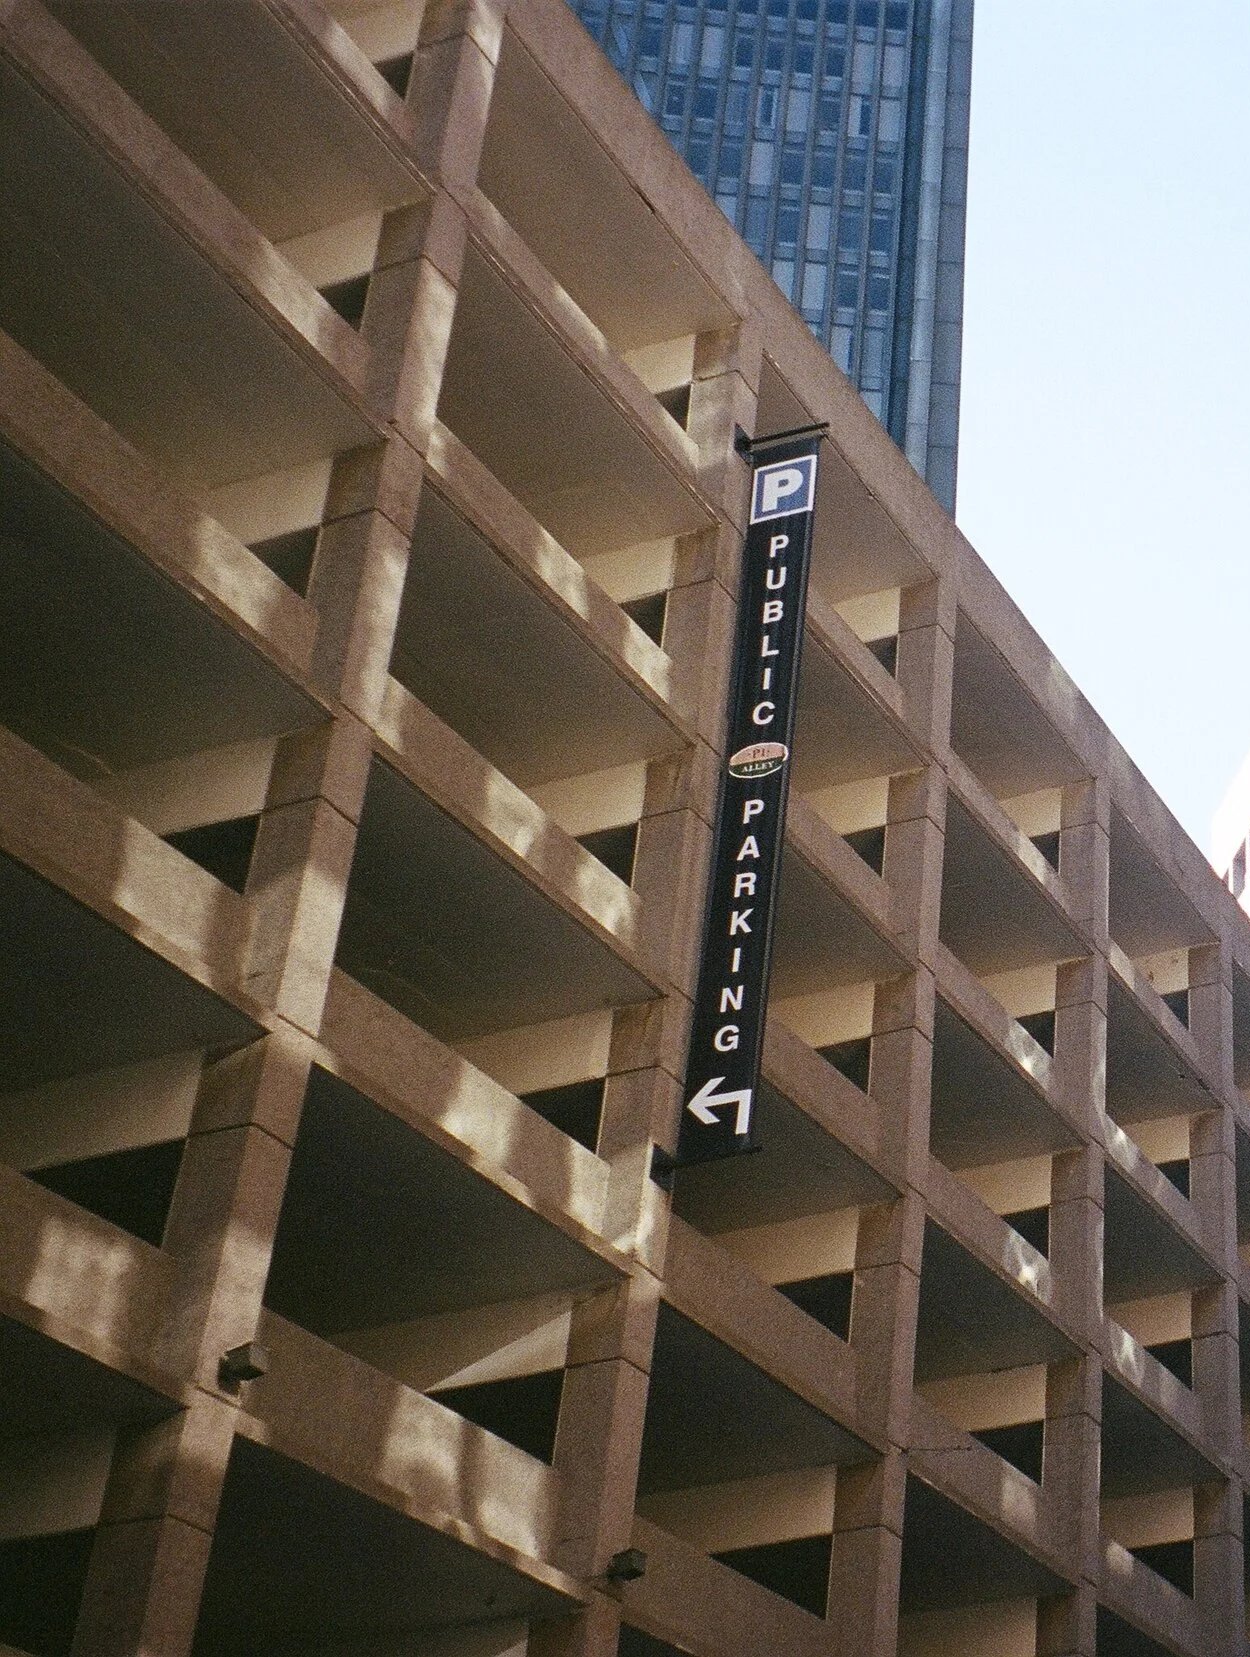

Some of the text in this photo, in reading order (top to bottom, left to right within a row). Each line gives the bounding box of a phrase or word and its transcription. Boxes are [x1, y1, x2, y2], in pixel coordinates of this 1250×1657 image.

[761, 468, 804, 513] P
[752, 534, 789, 725] PUBLIC
[742, 760, 775, 772] ALLEY
[714, 799, 765, 1051] PARKING
